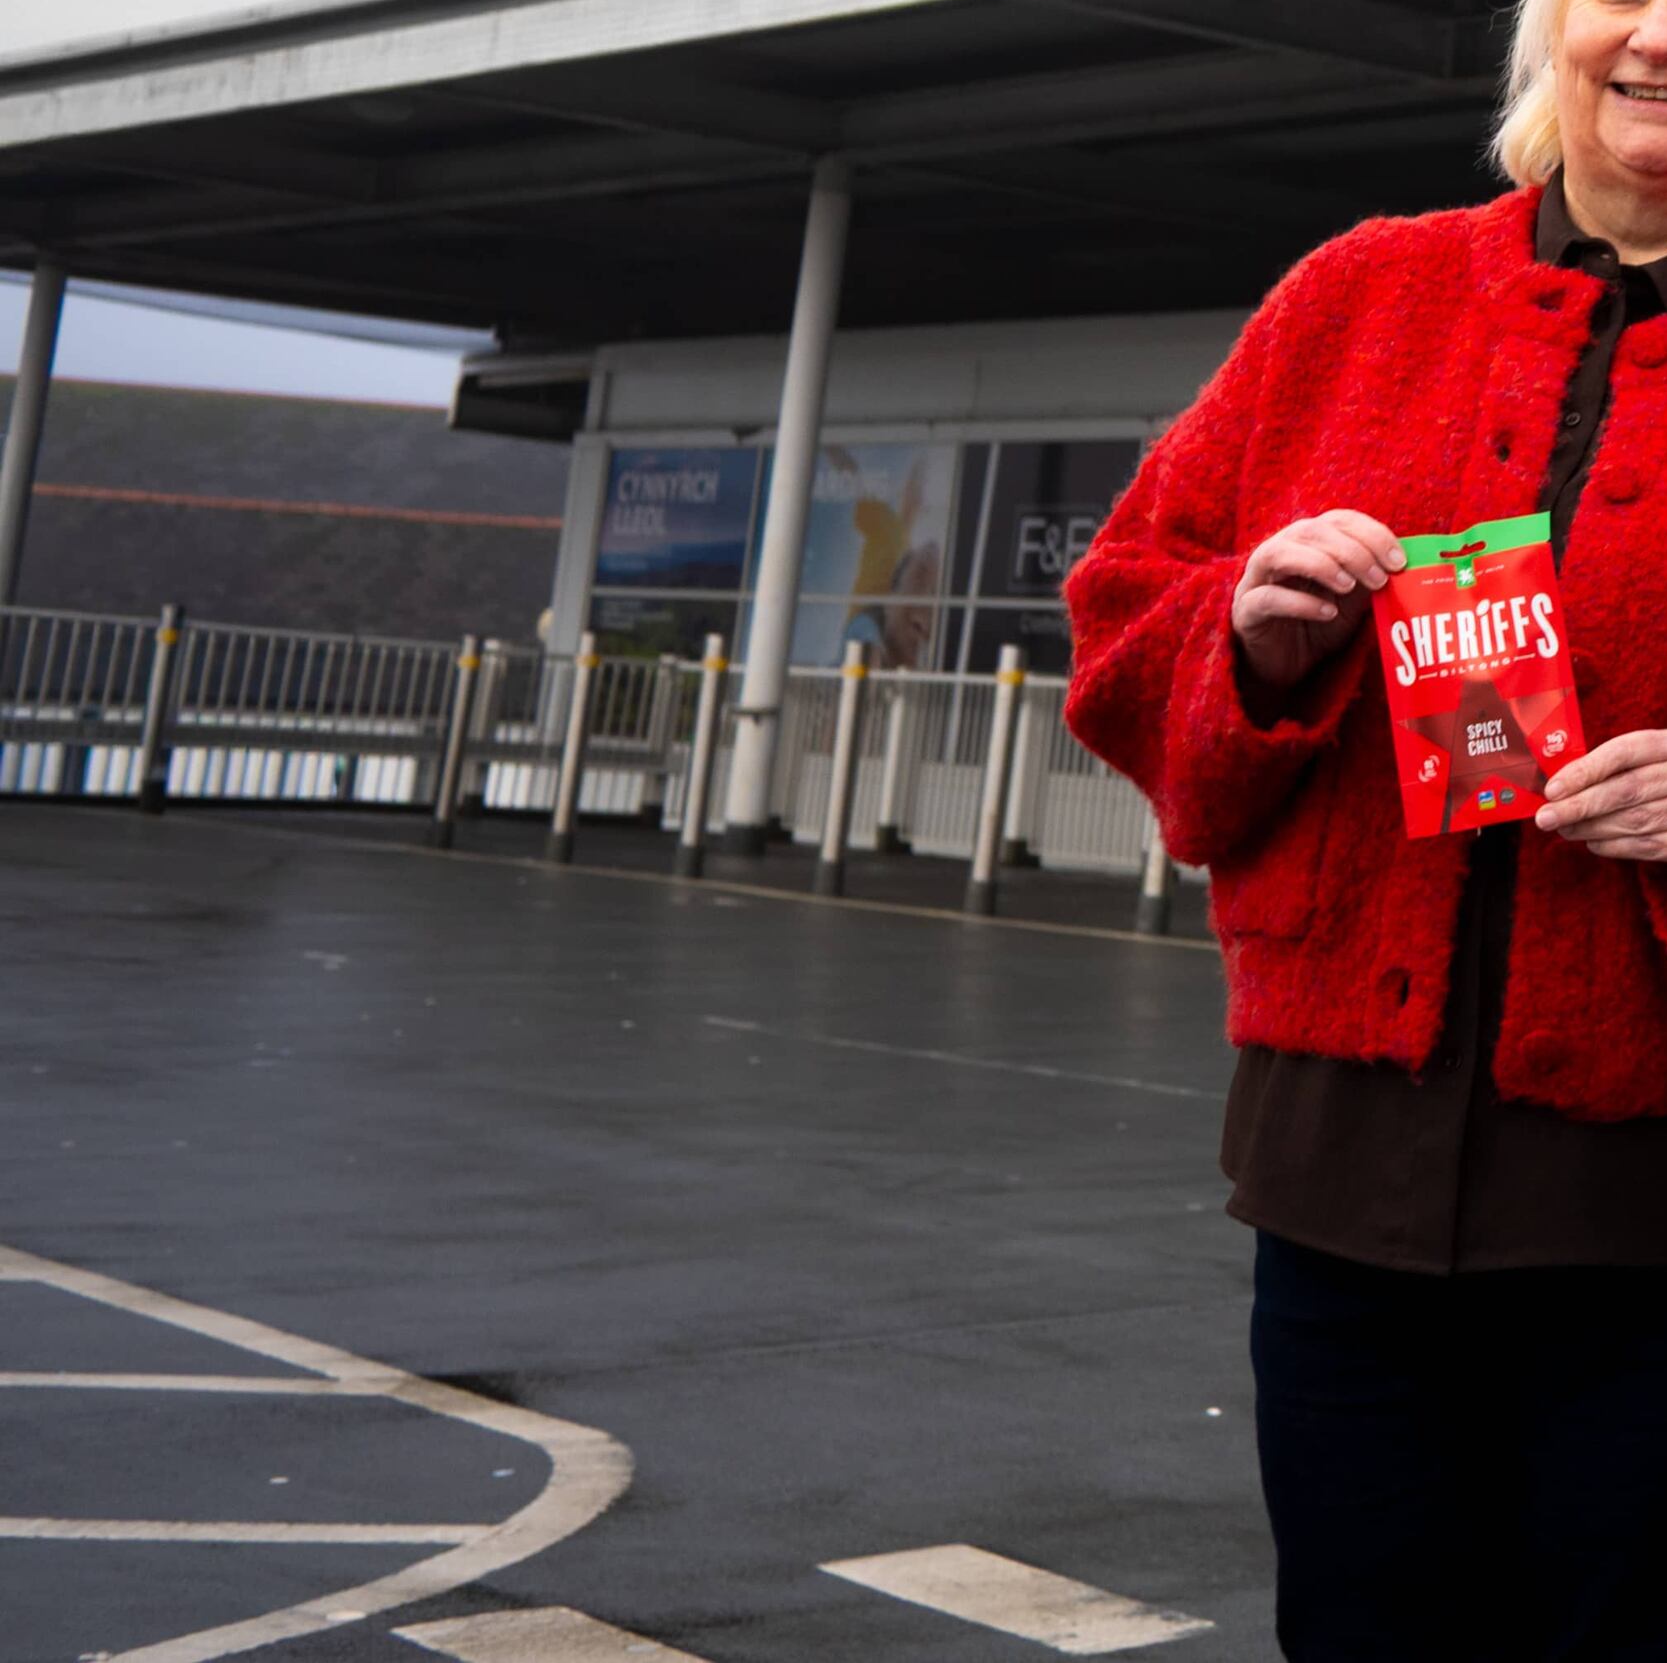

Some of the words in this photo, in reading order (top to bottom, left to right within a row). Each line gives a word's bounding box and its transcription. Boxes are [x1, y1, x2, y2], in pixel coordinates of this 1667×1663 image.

[1015, 517, 1096, 578] F&F
[1439, 657, 1511, 678] BILTONG
[1466, 718, 1503, 741] SPICY
[1467, 734, 1508, 757] CHILLI
